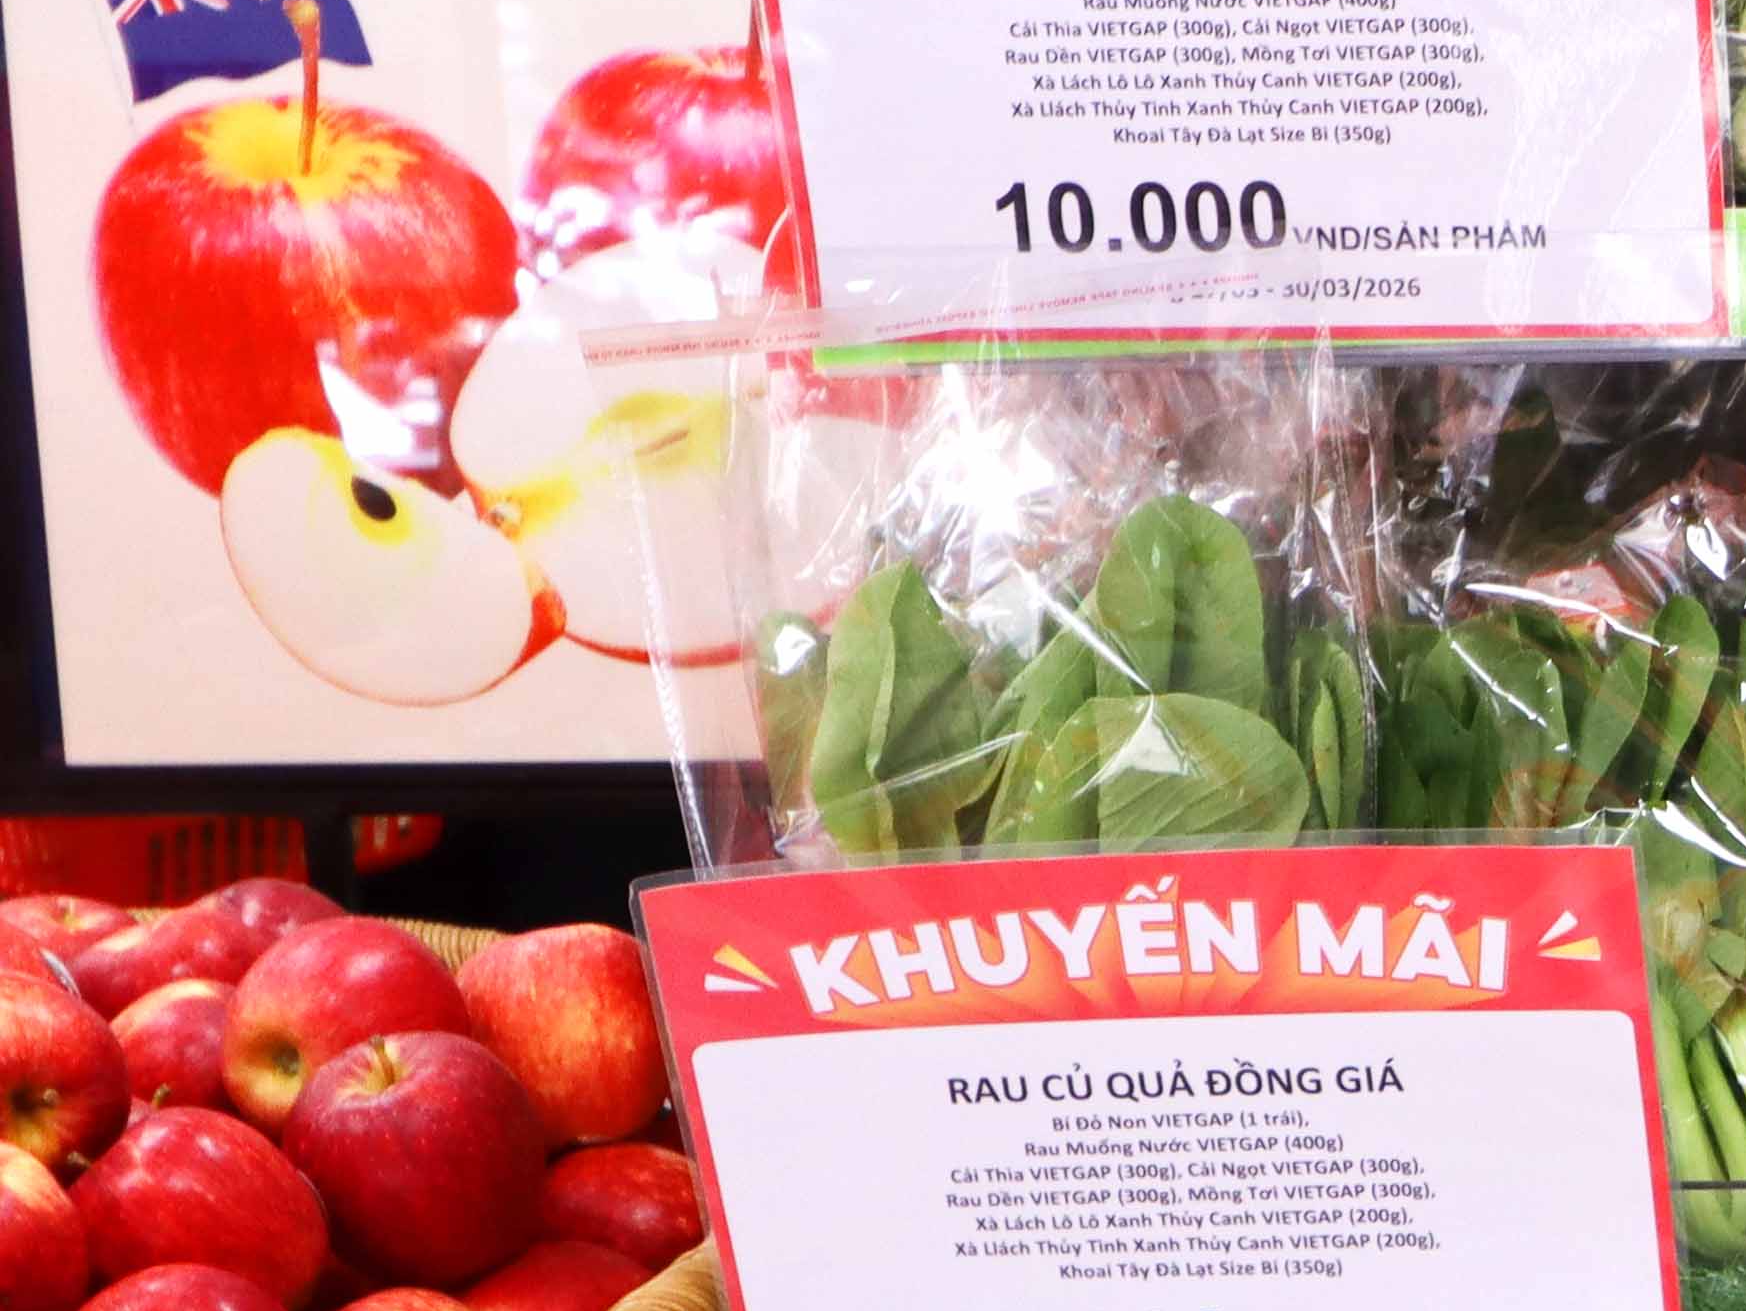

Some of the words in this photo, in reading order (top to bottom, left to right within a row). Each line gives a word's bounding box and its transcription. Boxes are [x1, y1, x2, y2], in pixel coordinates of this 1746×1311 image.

[995, 180, 1287, 254] 10.000
[789, 876, 1262, 1017] KHUYẾN
[1298, 894, 1508, 992] MÃI
[947, 1074, 1029, 1104] RAU
[1041, 1062, 1093, 1101] CỦ
[1106, 1059, 1196, 1102] QUẢ
[1204, 1058, 1323, 1096] ĐỒNG
[1335, 1057, 1405, 1094] GIÁ
[1051, 1116, 1071, 1132] Bí
[1075, 1113, 1103, 1131] Đỏ
[1107, 1114, 1148, 1130] Non
[1151, 1111, 1235, 1128] VIETGAP
[1239, 1110, 1258, 1129] (1
[1024, 1142, 1061, 1157] Rau
[1065, 1137, 1134, 1157] Muống
[1138, 1137, 1192, 1154] Nước
[1196, 1135, 1279, 1152] VIETGAP
[1284, 1133, 1344, 1153] (400g)
